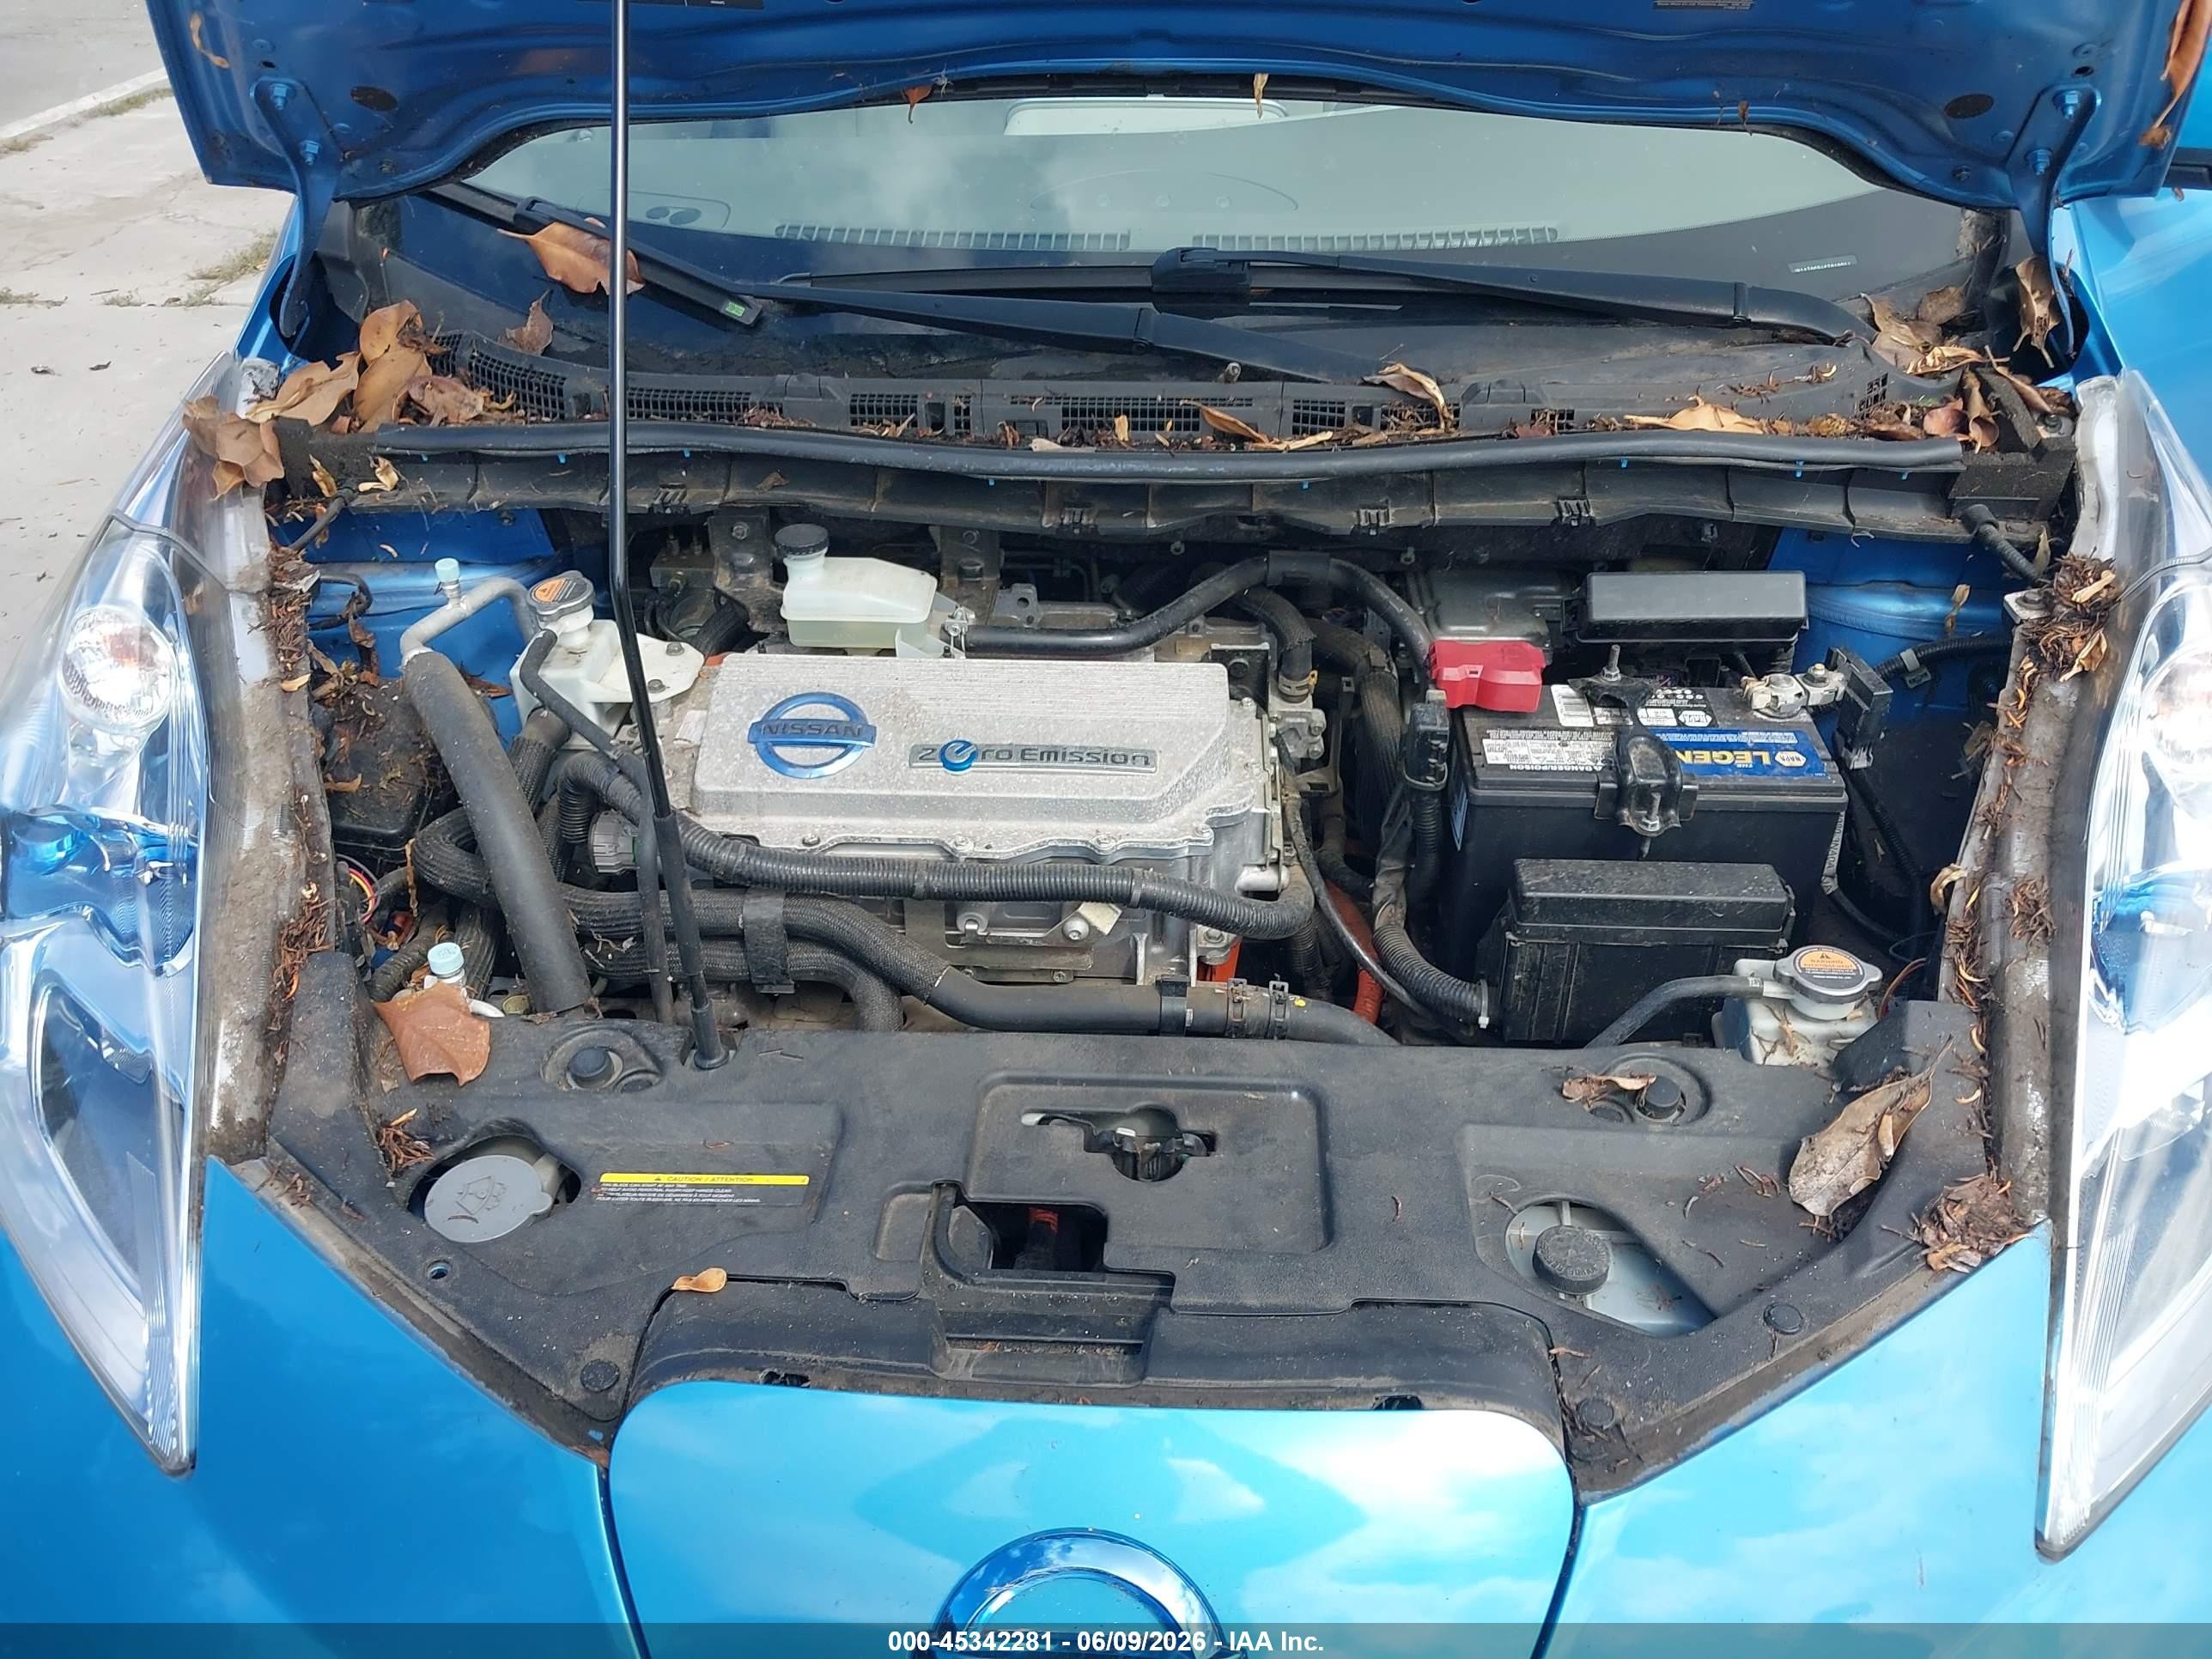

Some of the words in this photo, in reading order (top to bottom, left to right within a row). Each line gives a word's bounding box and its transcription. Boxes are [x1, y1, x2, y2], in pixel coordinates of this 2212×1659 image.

[761, 721, 863, 738] NISSAN
[1021, 748, 1151, 767] Emission
[1675, 749, 1771, 764] LEGEN
[1779, 754, 1801, 763] NAPA
[1509, 763, 1593, 772] DANGER/POISON
